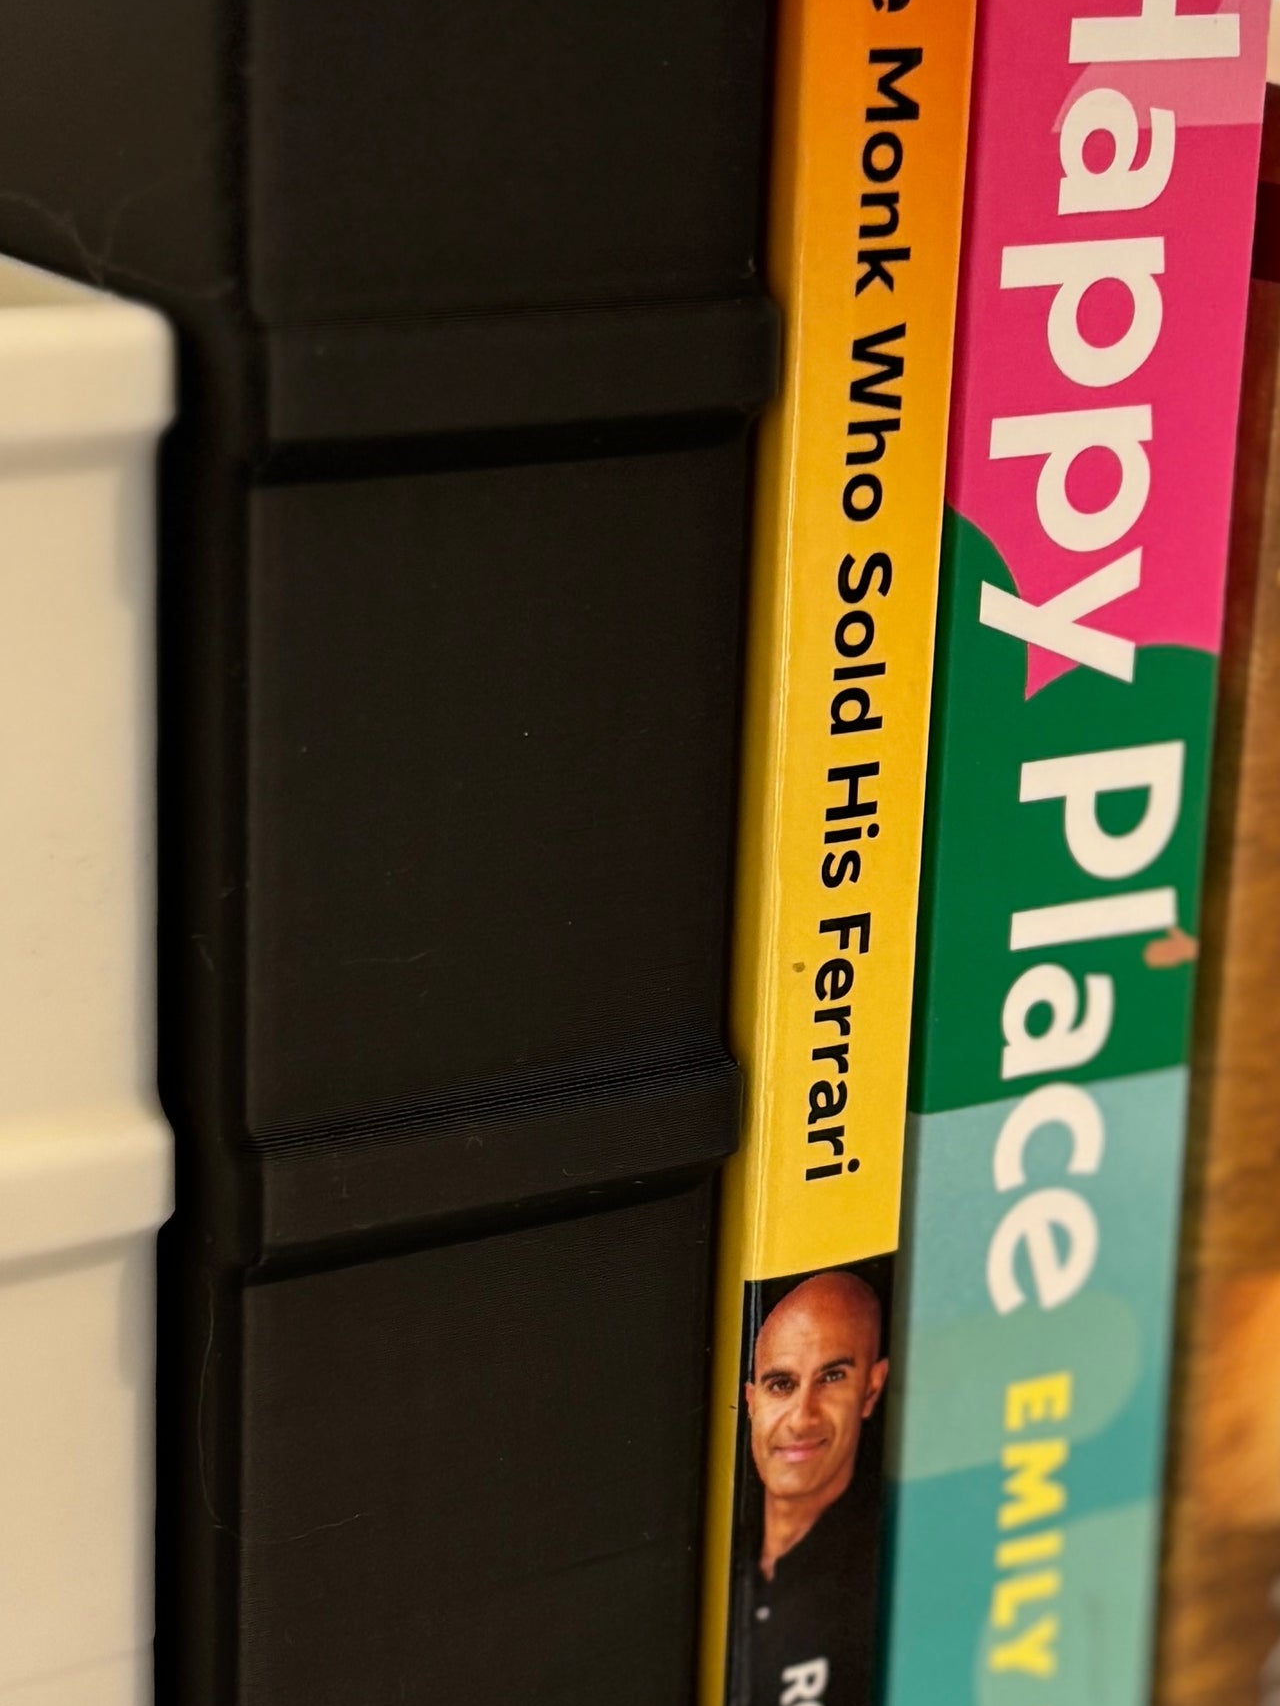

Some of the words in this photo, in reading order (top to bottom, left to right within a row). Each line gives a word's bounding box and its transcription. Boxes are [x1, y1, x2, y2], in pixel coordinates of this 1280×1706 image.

[855, 46, 924, 297] Monk
[842, 322, 907, 524] Who
[829, 551, 893, 736] Sold
[820, 759, 881, 891] His
[804, 912, 872, 1183] Ferrari
[985, 740, 1186, 1316] Place
[988, 1370, 1072, 1679] EMILY
